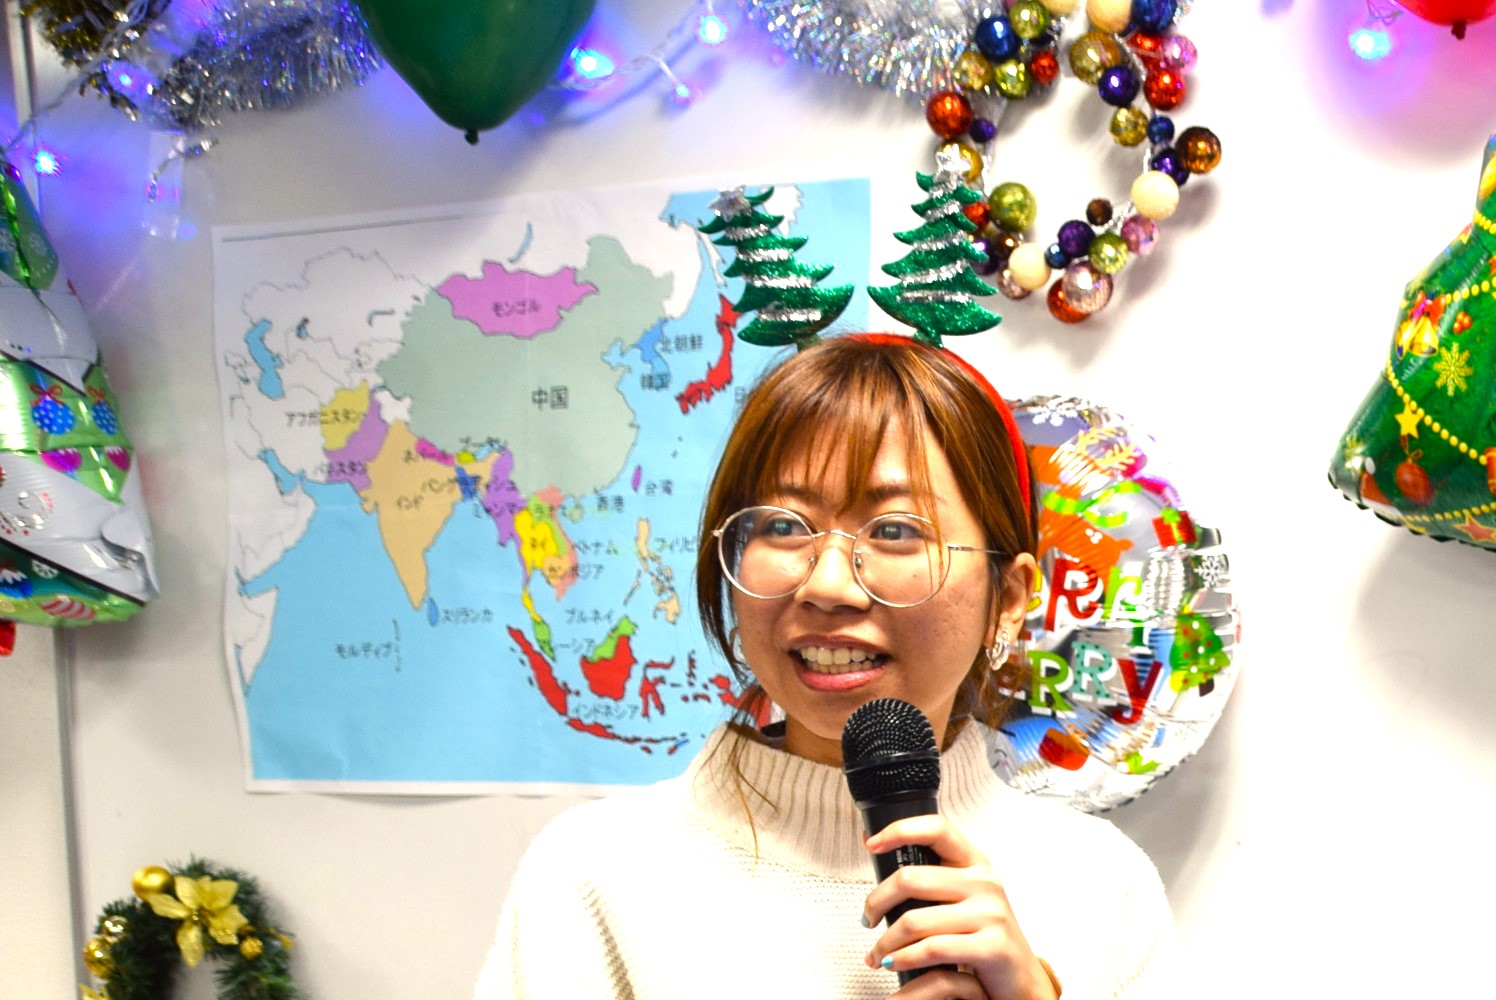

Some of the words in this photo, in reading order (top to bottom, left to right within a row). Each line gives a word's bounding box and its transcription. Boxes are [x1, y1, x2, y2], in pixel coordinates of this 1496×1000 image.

[491, 300, 541, 317] モンゴル
[640, 372, 669, 391] 韓国
[531, 385, 569, 409] 中国
[654, 536, 698, 553] フィリピ
[441, 606, 493, 624] スリランカ
